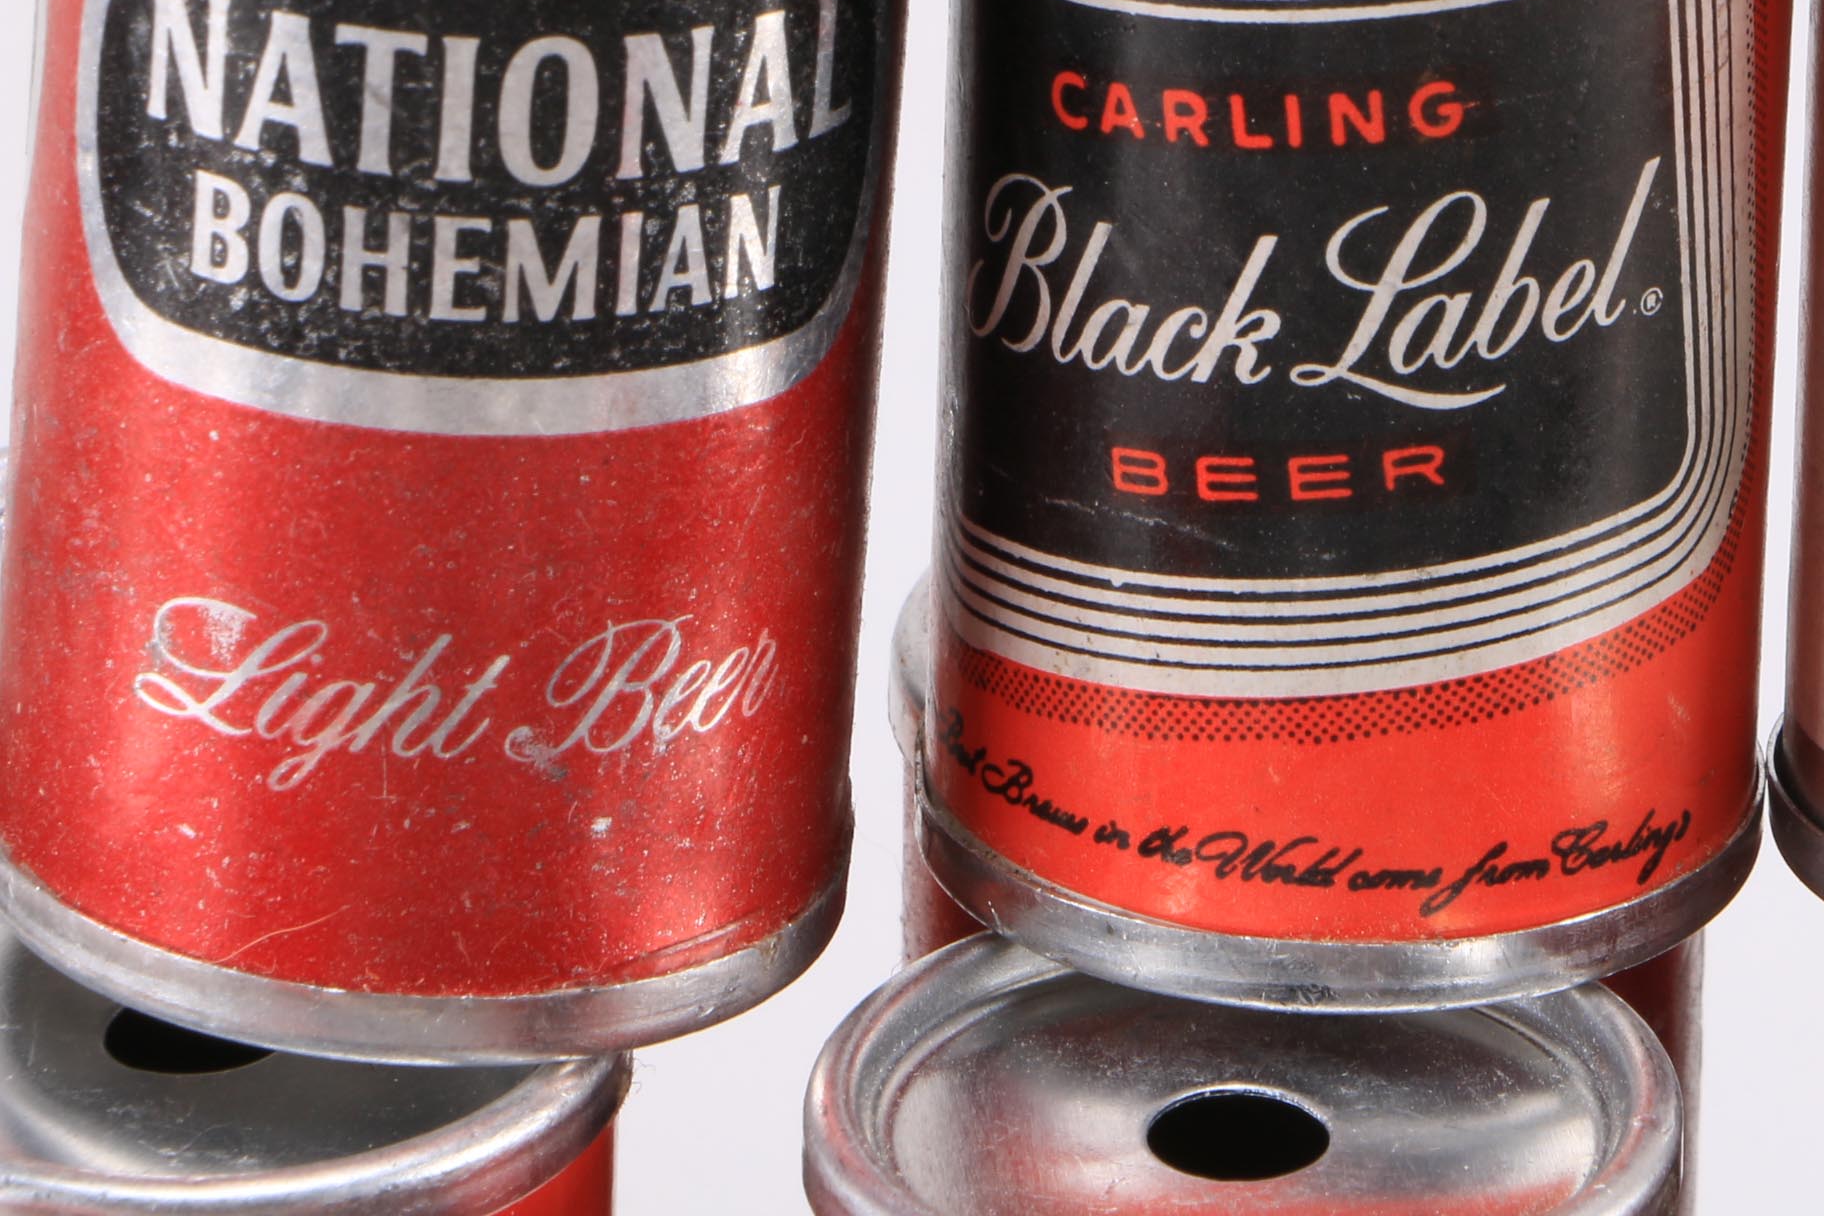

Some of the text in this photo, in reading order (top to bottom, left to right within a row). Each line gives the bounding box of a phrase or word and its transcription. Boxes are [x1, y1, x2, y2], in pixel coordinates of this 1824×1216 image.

[1051, 70, 1464, 150] CARLING
[190, 169, 782, 324] BOHEMIAN
[965, 173, 1281, 384] Black
[1290, 157, 1661, 410] Label
[1111, 446, 1444, 502] BEER
[133, 596, 778, 791] Light Beer
[1137, 825, 1194, 867] the
[1195, 831, 1364, 888] World
[1347, 867, 1443, 892] come
[1419, 841, 1550, 918] from
